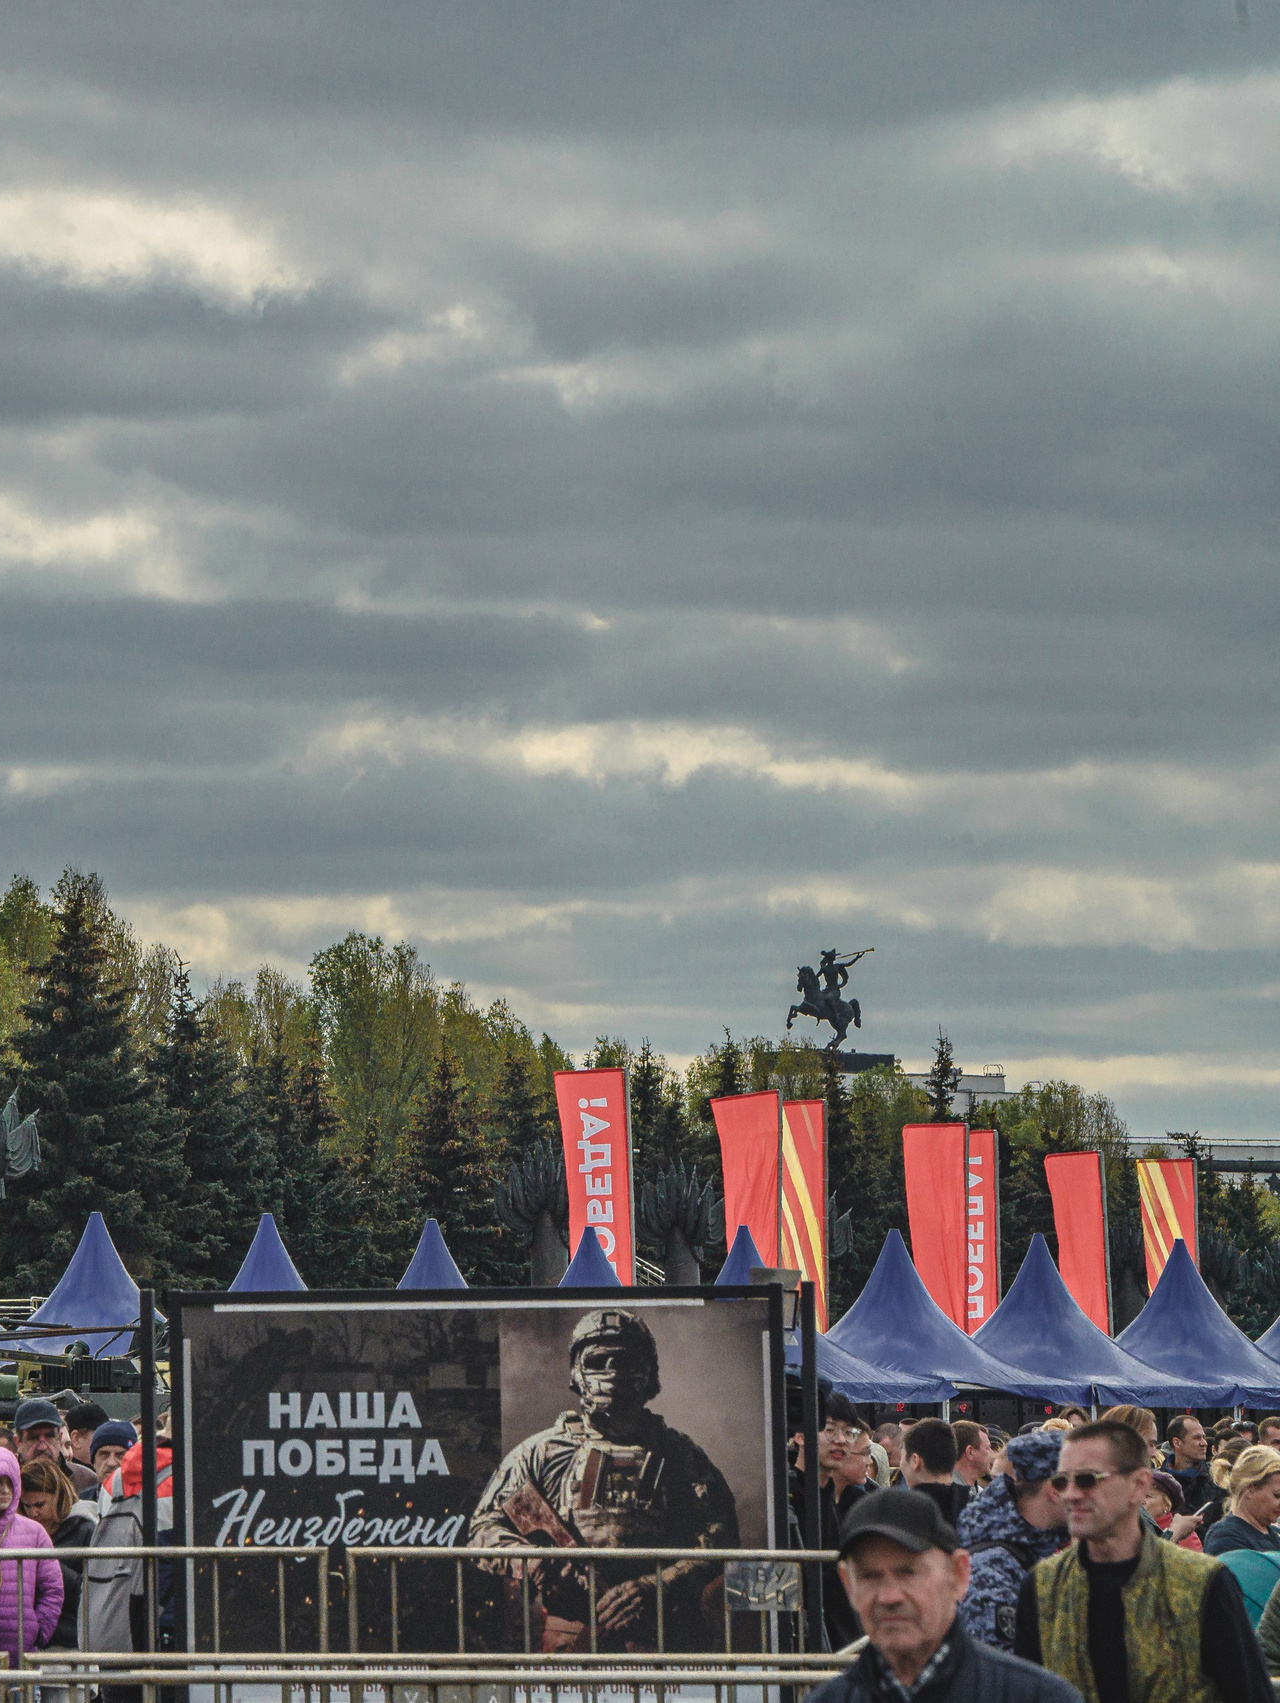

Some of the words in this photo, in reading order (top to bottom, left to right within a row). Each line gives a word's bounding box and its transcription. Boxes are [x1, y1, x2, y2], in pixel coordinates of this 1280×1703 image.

[268, 1391, 422, 1429] НАША
[242, 1438, 450, 1484] ПОБЕДА
[212, 1489, 465, 1562] Неизбежна
